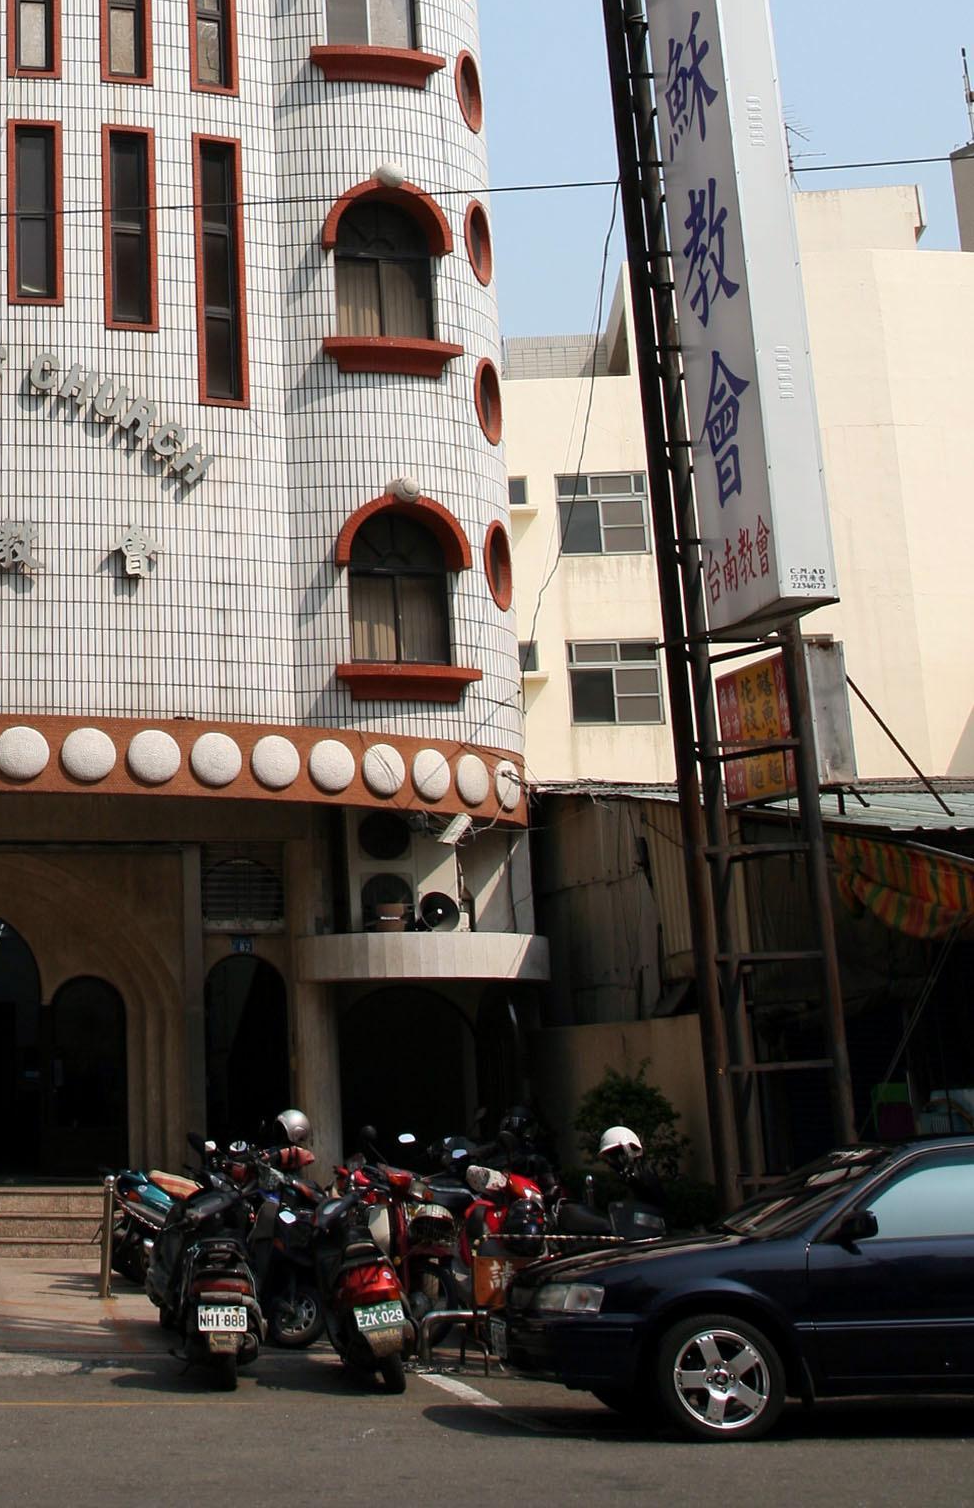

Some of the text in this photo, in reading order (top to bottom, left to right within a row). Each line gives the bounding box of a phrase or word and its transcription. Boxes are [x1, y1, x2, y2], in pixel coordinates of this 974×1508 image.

[29, 352, 215, 487] CHURCH
[706, 514, 771, 607] 台南教會
[199, 1313, 246, 1327] NHI-888
[356, 1308, 405, 1328] EZK-029
